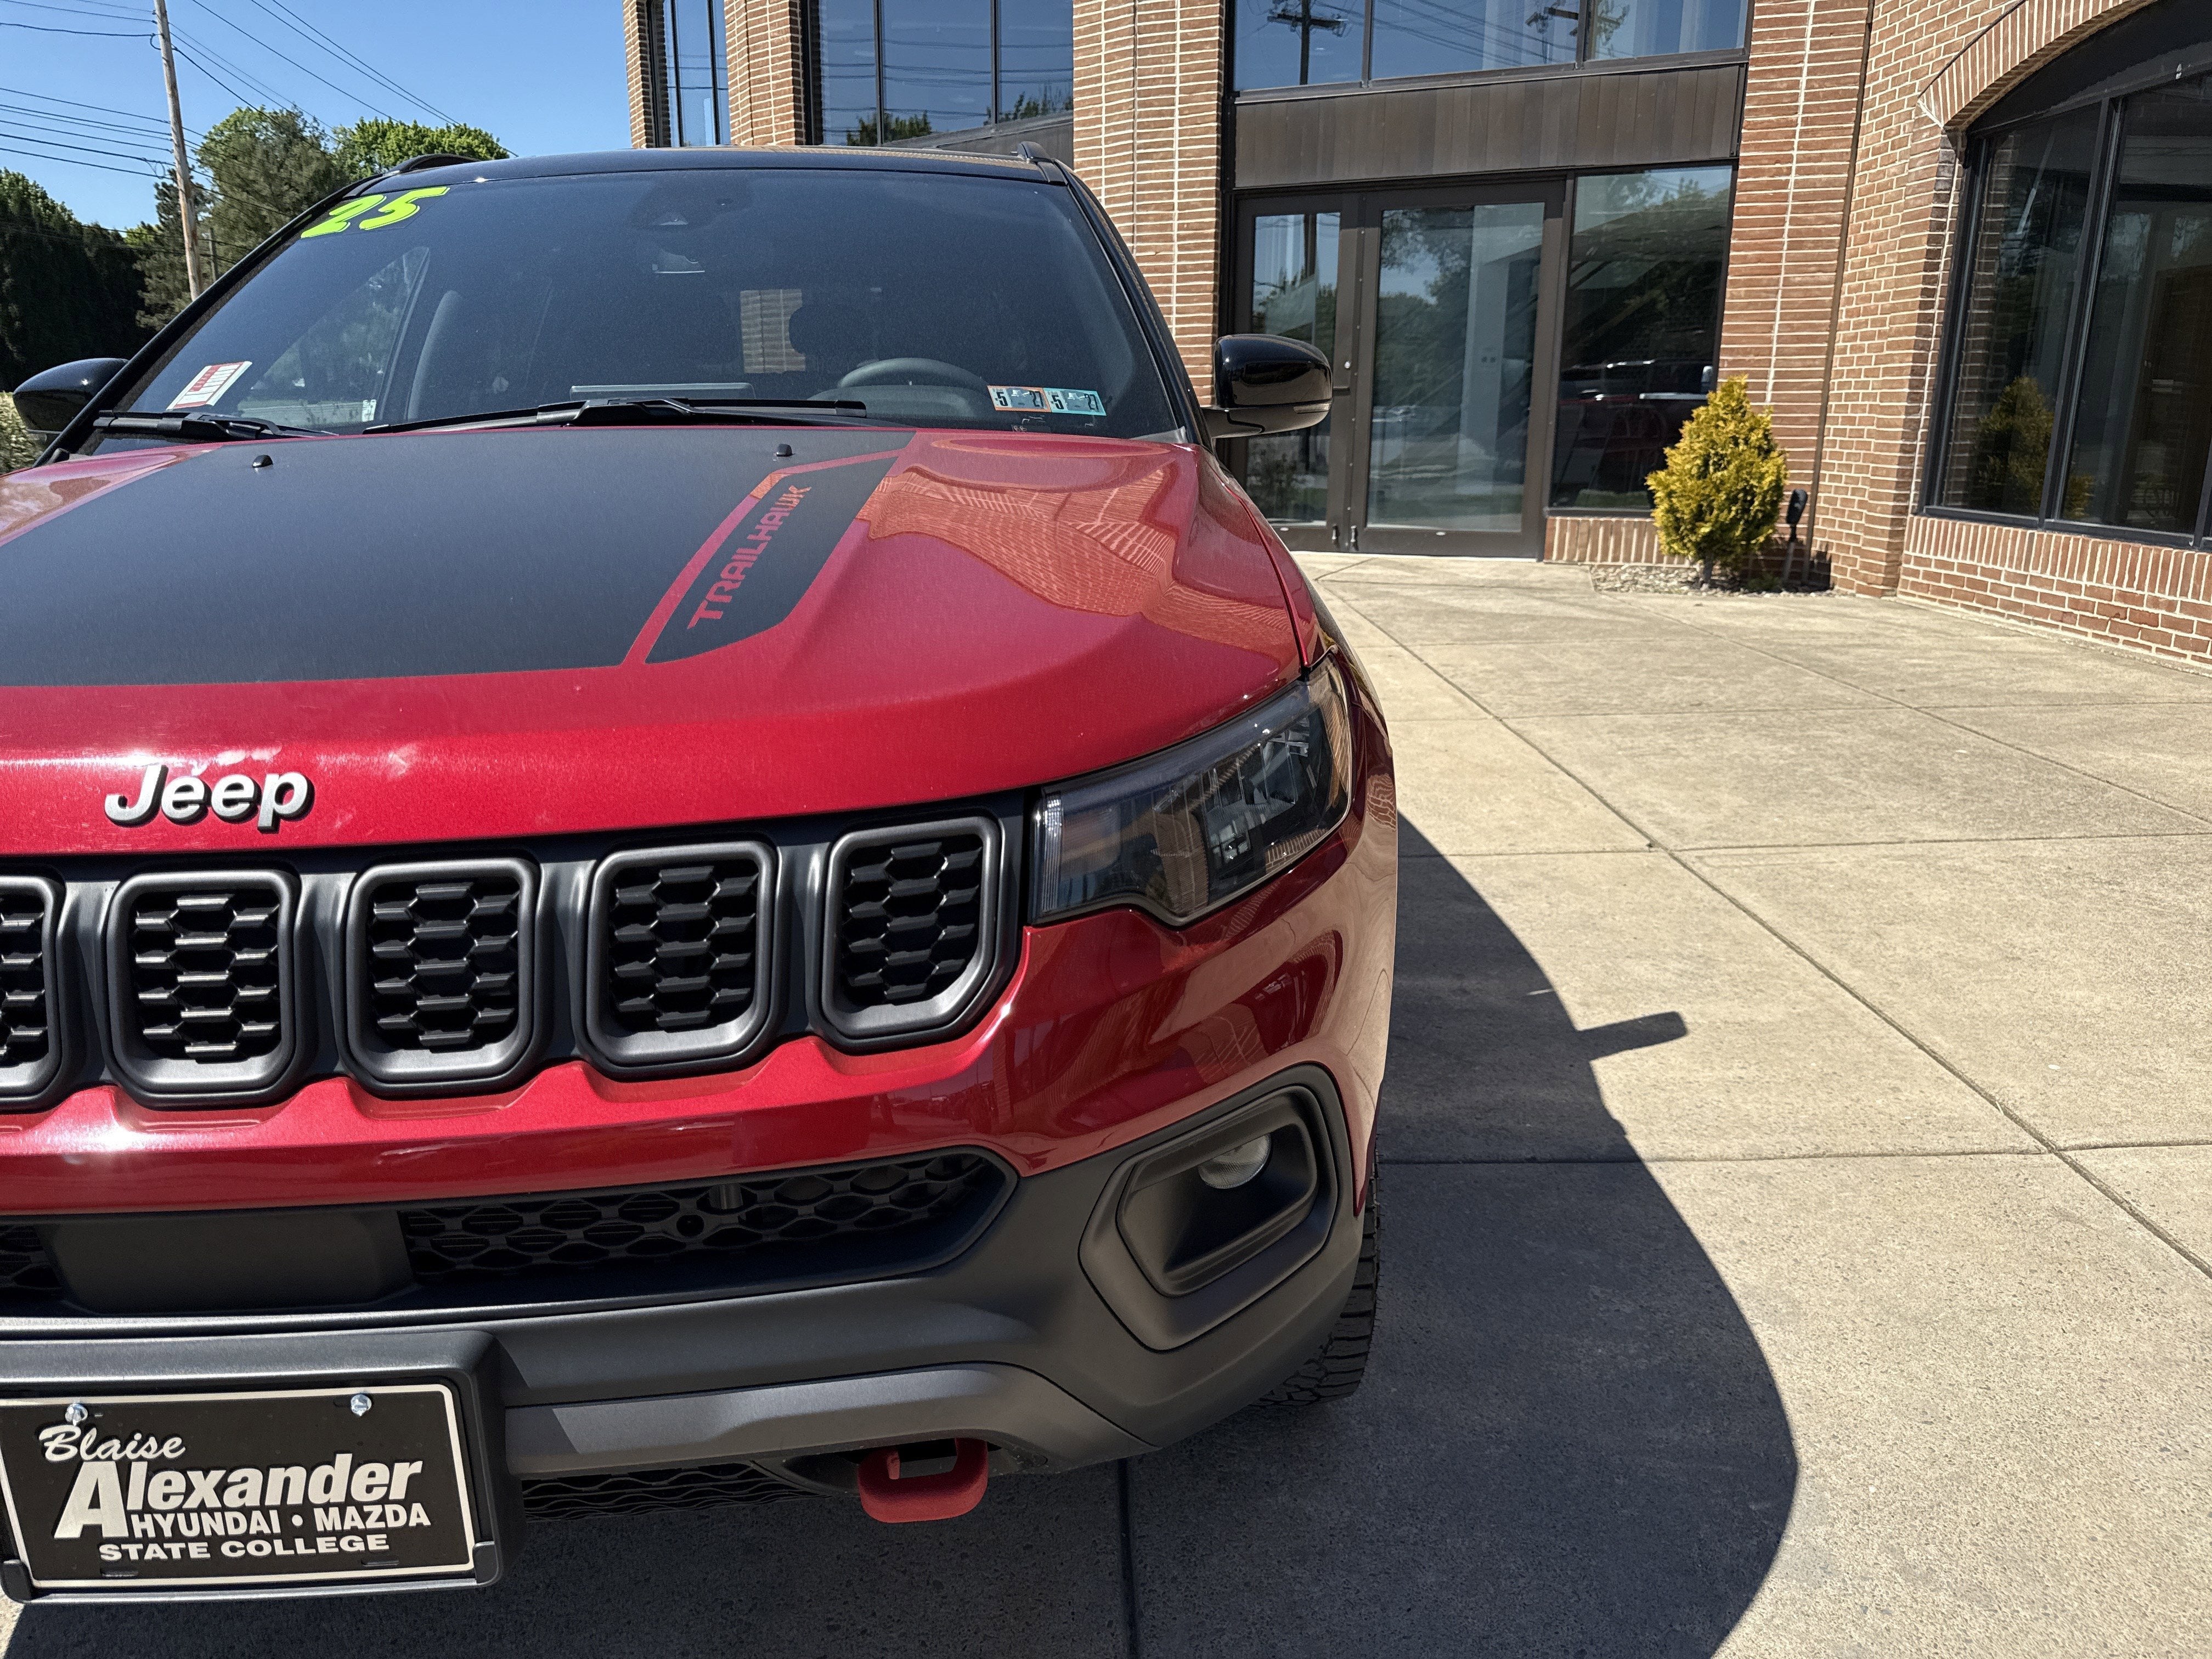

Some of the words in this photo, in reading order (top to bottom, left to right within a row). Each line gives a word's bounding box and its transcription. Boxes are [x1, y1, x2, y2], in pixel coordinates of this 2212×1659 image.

[301, 187, 450, 238] 25
[996, 392, 1008, 407] 5
[1051, 394, 1064, 410] 5
[687, 484, 811, 630] TRAILHAWK
[104, 764, 314, 834] Jeep
[39, 1424, 187, 1462] Blaise
[53, 1453, 423, 1540] Alexander
[131, 1509, 283, 1539] HYUNDAI
[315, 1502, 431, 1531] MAZDA
[99, 1541, 211, 1561] STATE
[221, 1533, 390, 1558] COLLEGE
